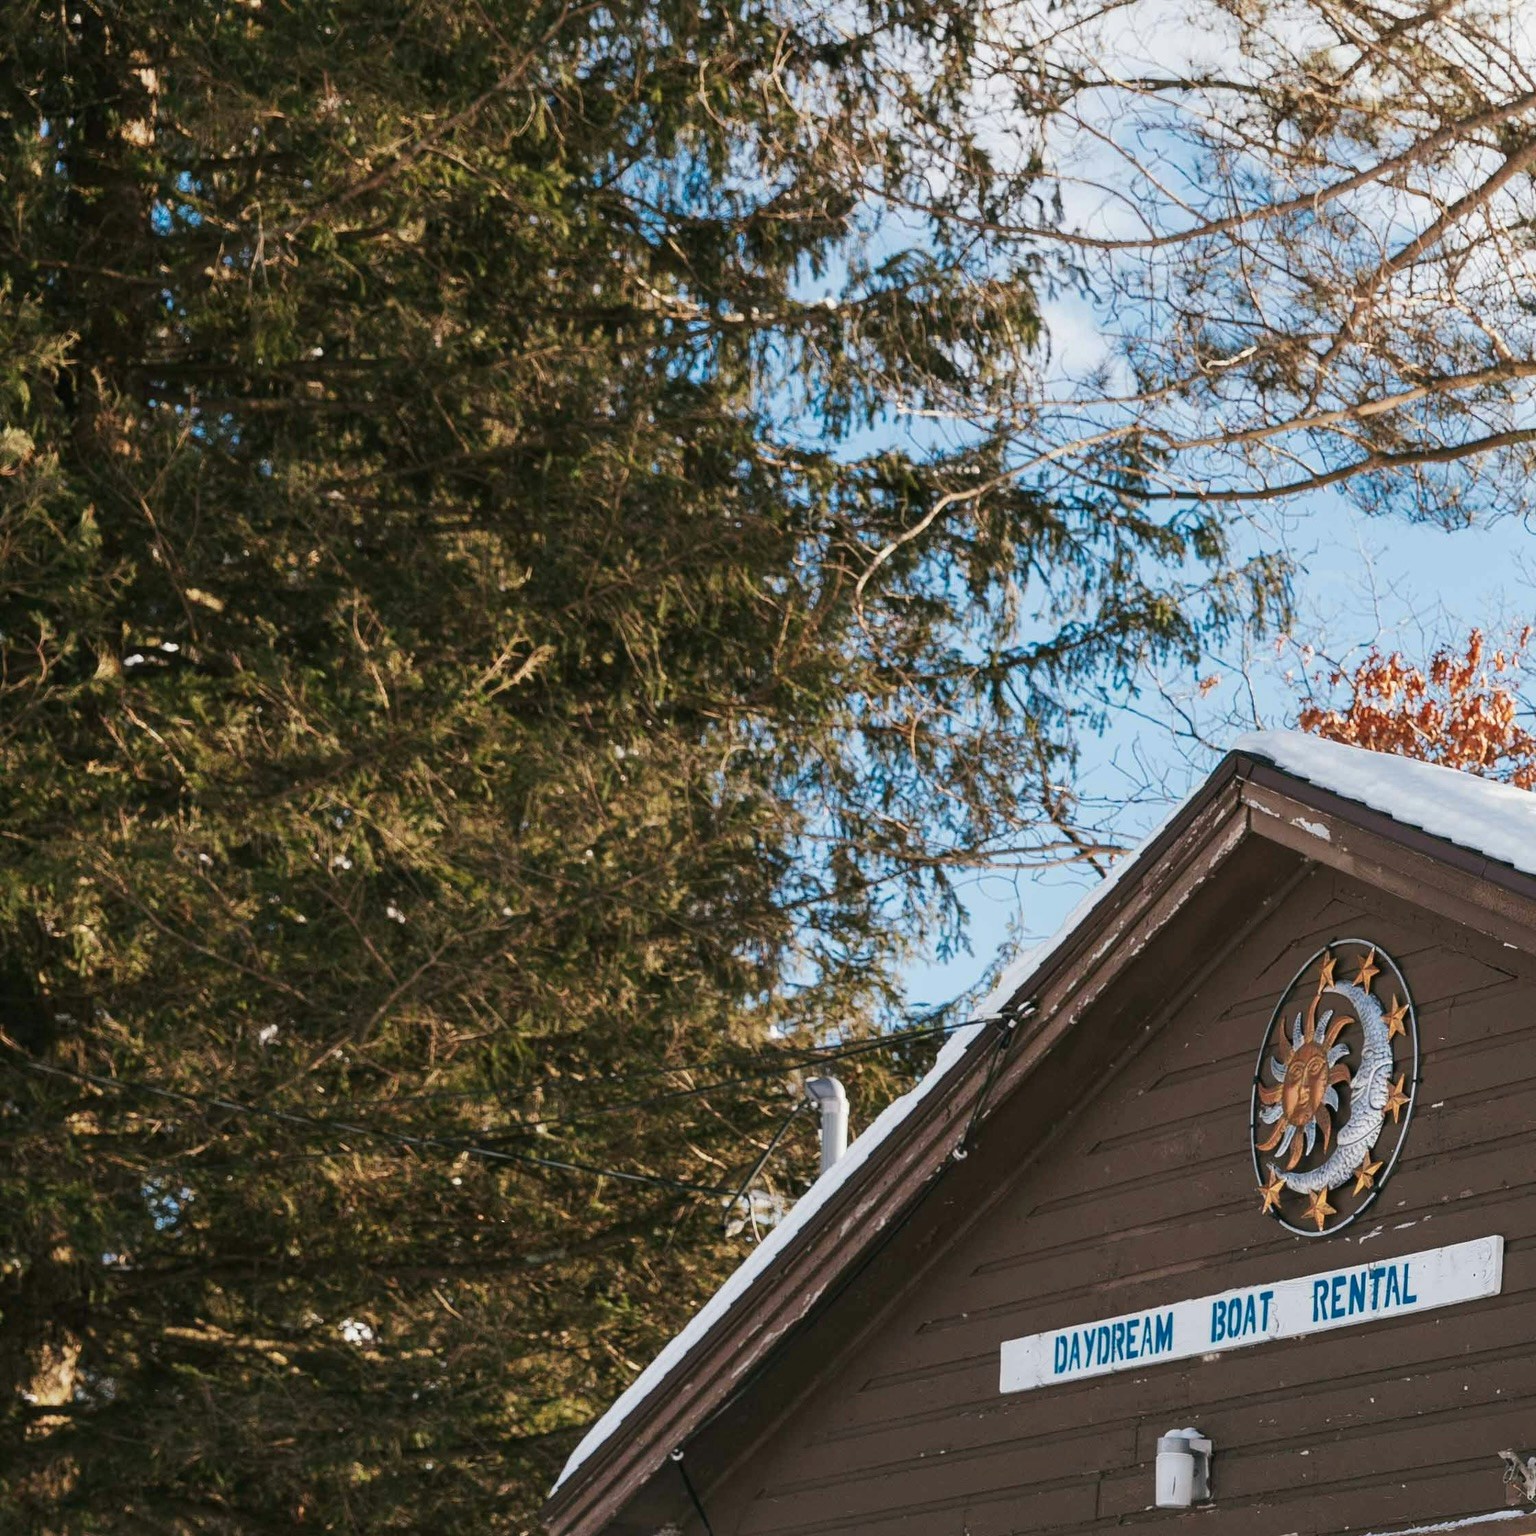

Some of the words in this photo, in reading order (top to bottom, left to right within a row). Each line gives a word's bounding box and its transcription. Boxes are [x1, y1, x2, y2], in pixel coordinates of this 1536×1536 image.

[1054, 1312, 1174, 1374] DAYDREAM
[1211, 1291, 1274, 1343] BOAT
[1313, 1263, 1417, 1322] RENTAL
